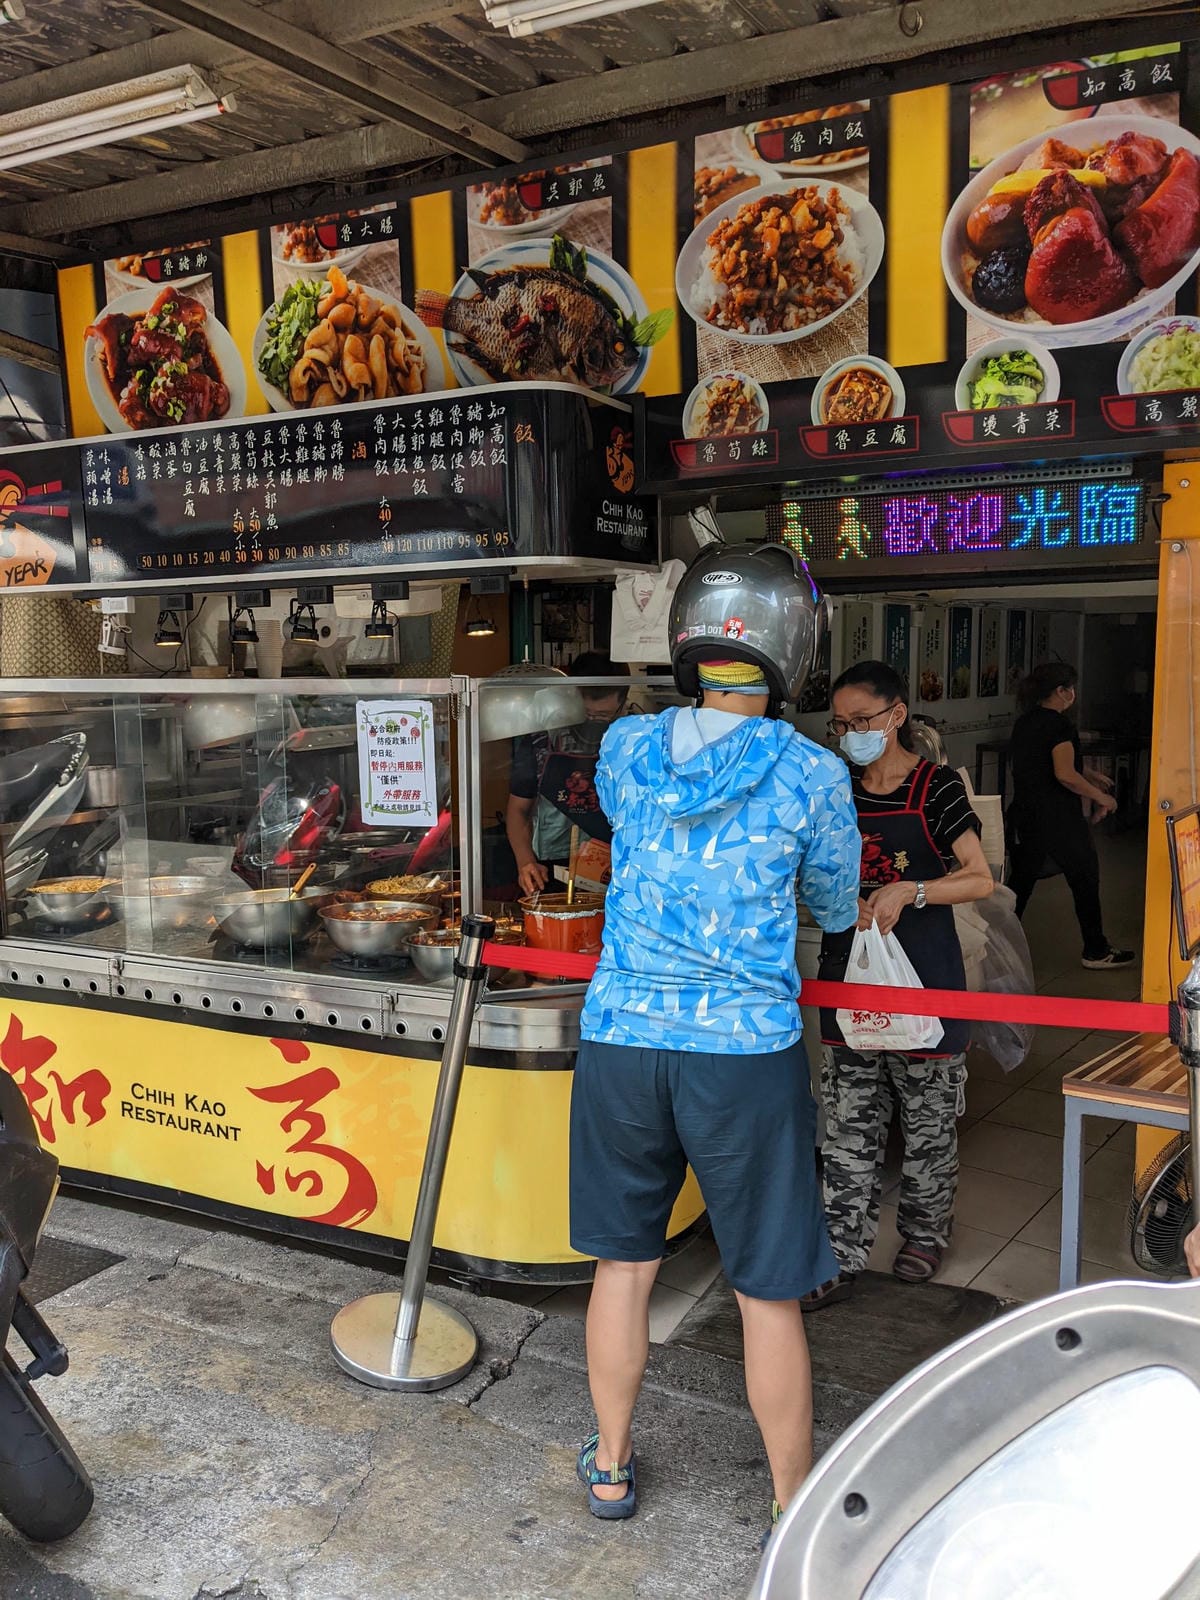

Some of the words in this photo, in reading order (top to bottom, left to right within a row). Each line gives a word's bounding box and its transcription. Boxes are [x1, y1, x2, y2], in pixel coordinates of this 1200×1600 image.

[1082, 63, 1173, 98] 知高飯
[790, 121, 864, 153] 魯肉飯
[546, 173, 606, 202] 吳郭魚
[340, 215, 393, 242] 魯大腸
[428, 407, 447, 471] 雞腿飯
[487, 401, 508, 466] 知高飯
[513, 423, 536, 444] 飯
[835, 424, 907, 451] 魯豆腐
[982, 410, 1062, 437] 燙青菜
[149, 442, 162, 479] 酸菜
[165, 441, 178, 478] 滷蛋
[245, 430, 259, 489] 魯筍絲
[278, 425, 294, 488] 魯大腸
[295, 423, 311, 484] 魯雞腿
[330, 419, 346, 482] 魯蹄膀
[352, 441, 367, 460] 滷
[373, 412, 390, 477] 魯肉飯
[391, 412, 409, 474] 大腸飯
[410, 409, 429, 495] 吳郭魚飯
[449, 404, 466, 494] 魯肉便當
[702, 440, 769, 464] 魯筍絲
[86, 449, 99, 506] 菜頭湯
[99, 449, 113, 504] 味噌湯
[118, 466, 130, 485] 湯
[135, 444, 147, 480] 香菇
[196, 437, 210, 495] 油豆腐
[212, 433, 226, 493] 燙青菜
[228, 432, 242, 492] 高麗菜
[596, 517, 648, 538] RESTAURANT
[602, 500, 623, 517] CHIH
[626, 505, 644, 521] KAO
[883, 484, 1141, 554] 歡迎光臨
[142, 556, 152, 568] 50
[157, 555, 168, 567] 10
[173, 554, 183, 566] 10
[188, 553, 198, 565] 15
[204, 552, 215, 564] 20
[220, 550, 231, 562] 40
[268, 548, 280, 561] 80
[285, 547, 297, 559] 90
[302, 545, 314, 558] 80
[320, 544, 332, 557] 85
[337, 543, 350, 556] 85
[397, 538, 412, 552] 120
[416, 537, 433, 551] 110
[437, 536, 453, 550] 110
[458, 535, 471, 548] 95
[475, 534, 489, 547] 95
[494, 532, 509, 546] 95
[4, 558, 48, 586] YEAR
[707, 625, 722, 635] DOT
[370, 724, 401, 734] 配合政府
[383, 789, 422, 800] 外帶服務
[0, 1013, 112, 1144] 知
[131, 1082, 175, 1107] CHIH
[185, 1093, 226, 1117] KAO
[121, 1101, 241, 1141] RESTAURANT
[245, 1038, 378, 1228] 高
